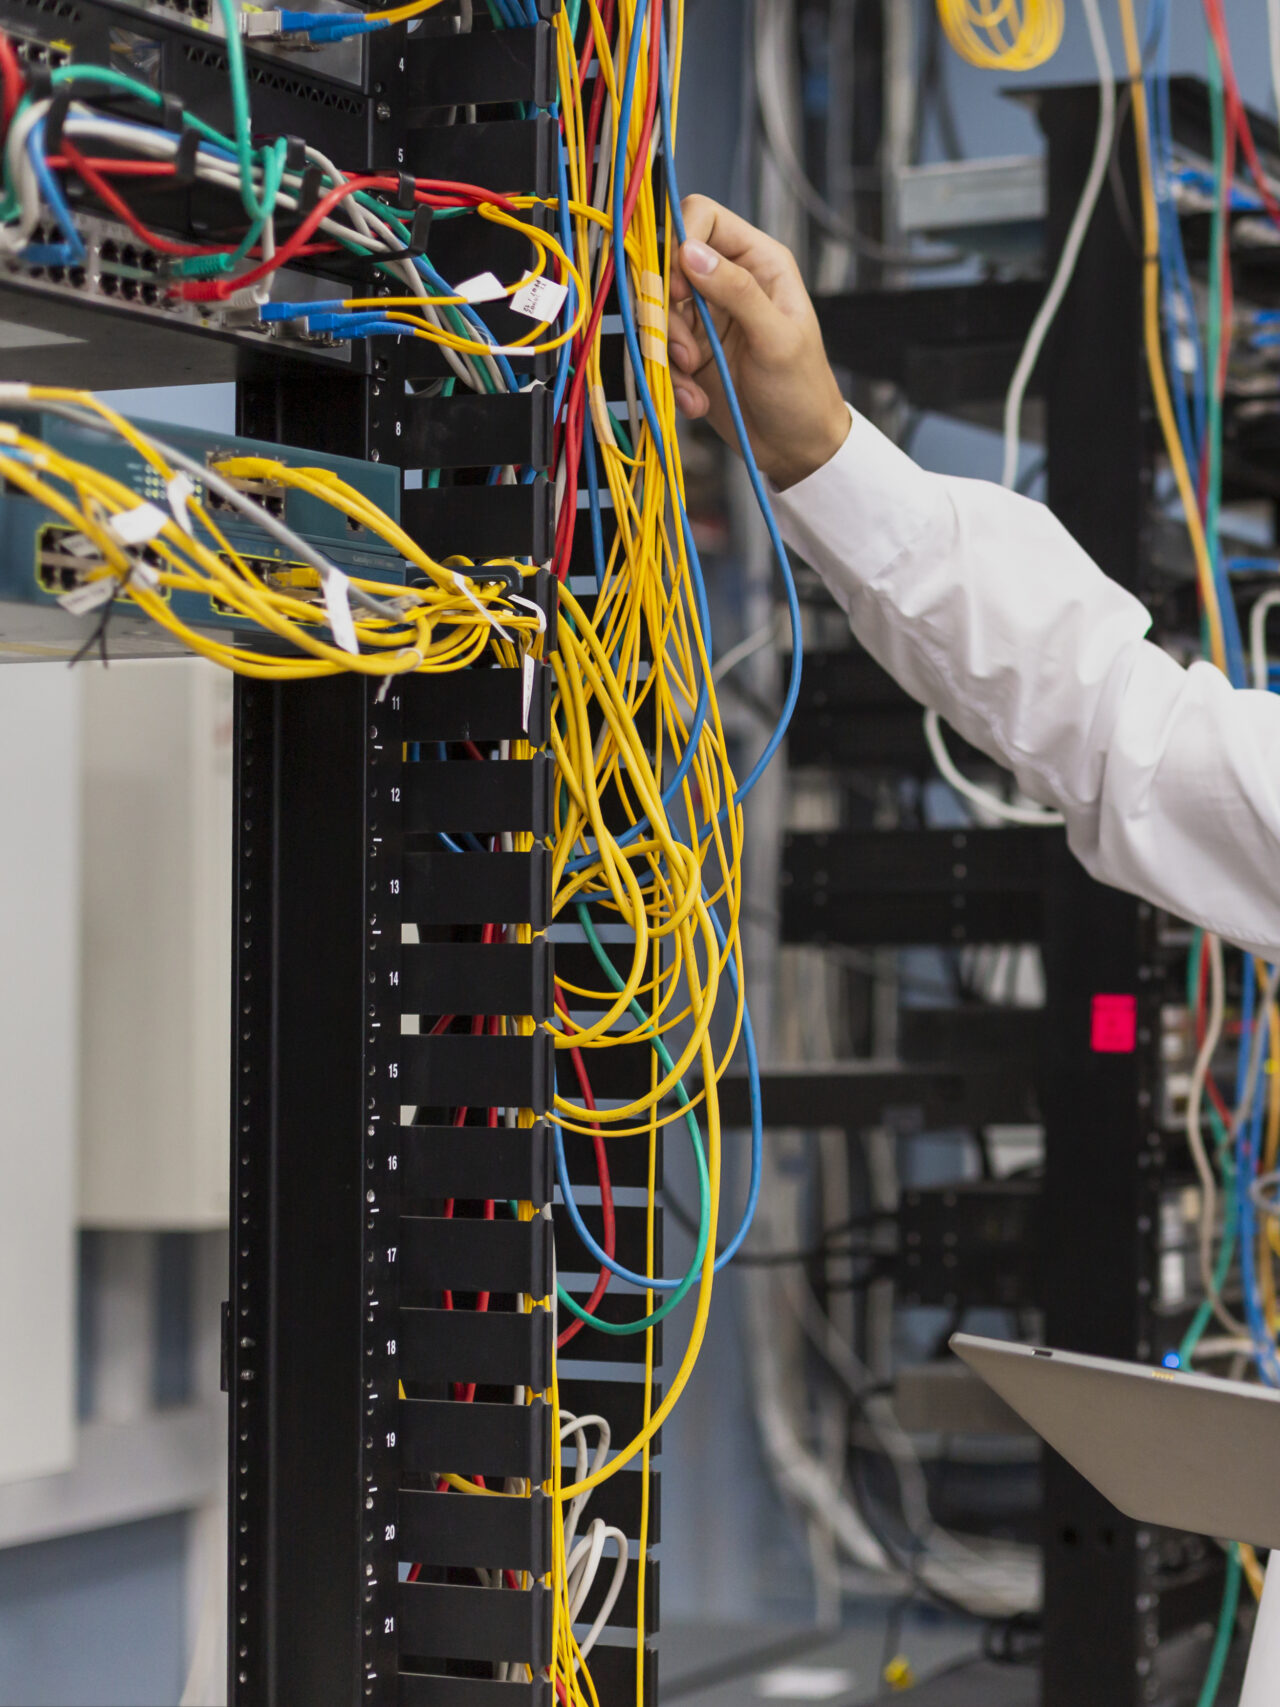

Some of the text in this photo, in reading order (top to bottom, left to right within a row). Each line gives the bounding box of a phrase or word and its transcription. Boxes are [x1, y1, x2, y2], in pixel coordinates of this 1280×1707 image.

[398, 57, 405, 72] 4
[397, 148, 404, 163] 5
[395, 421, 402, 437] 8
[391, 696, 400, 711] 11
[390, 787, 401, 803] 12
[389, 879, 400, 895] 13
[388, 970, 399, 986] 14
[388, 1062, 398, 1079] 15
[387, 1154, 398, 1171] 16
[386, 1247, 397, 1263] 17
[385, 1339, 396, 1356] 18
[385, 1431, 396, 1448] 19
[384, 1523, 395, 1541] 20
[384, 1616, 394, 1634] 21
